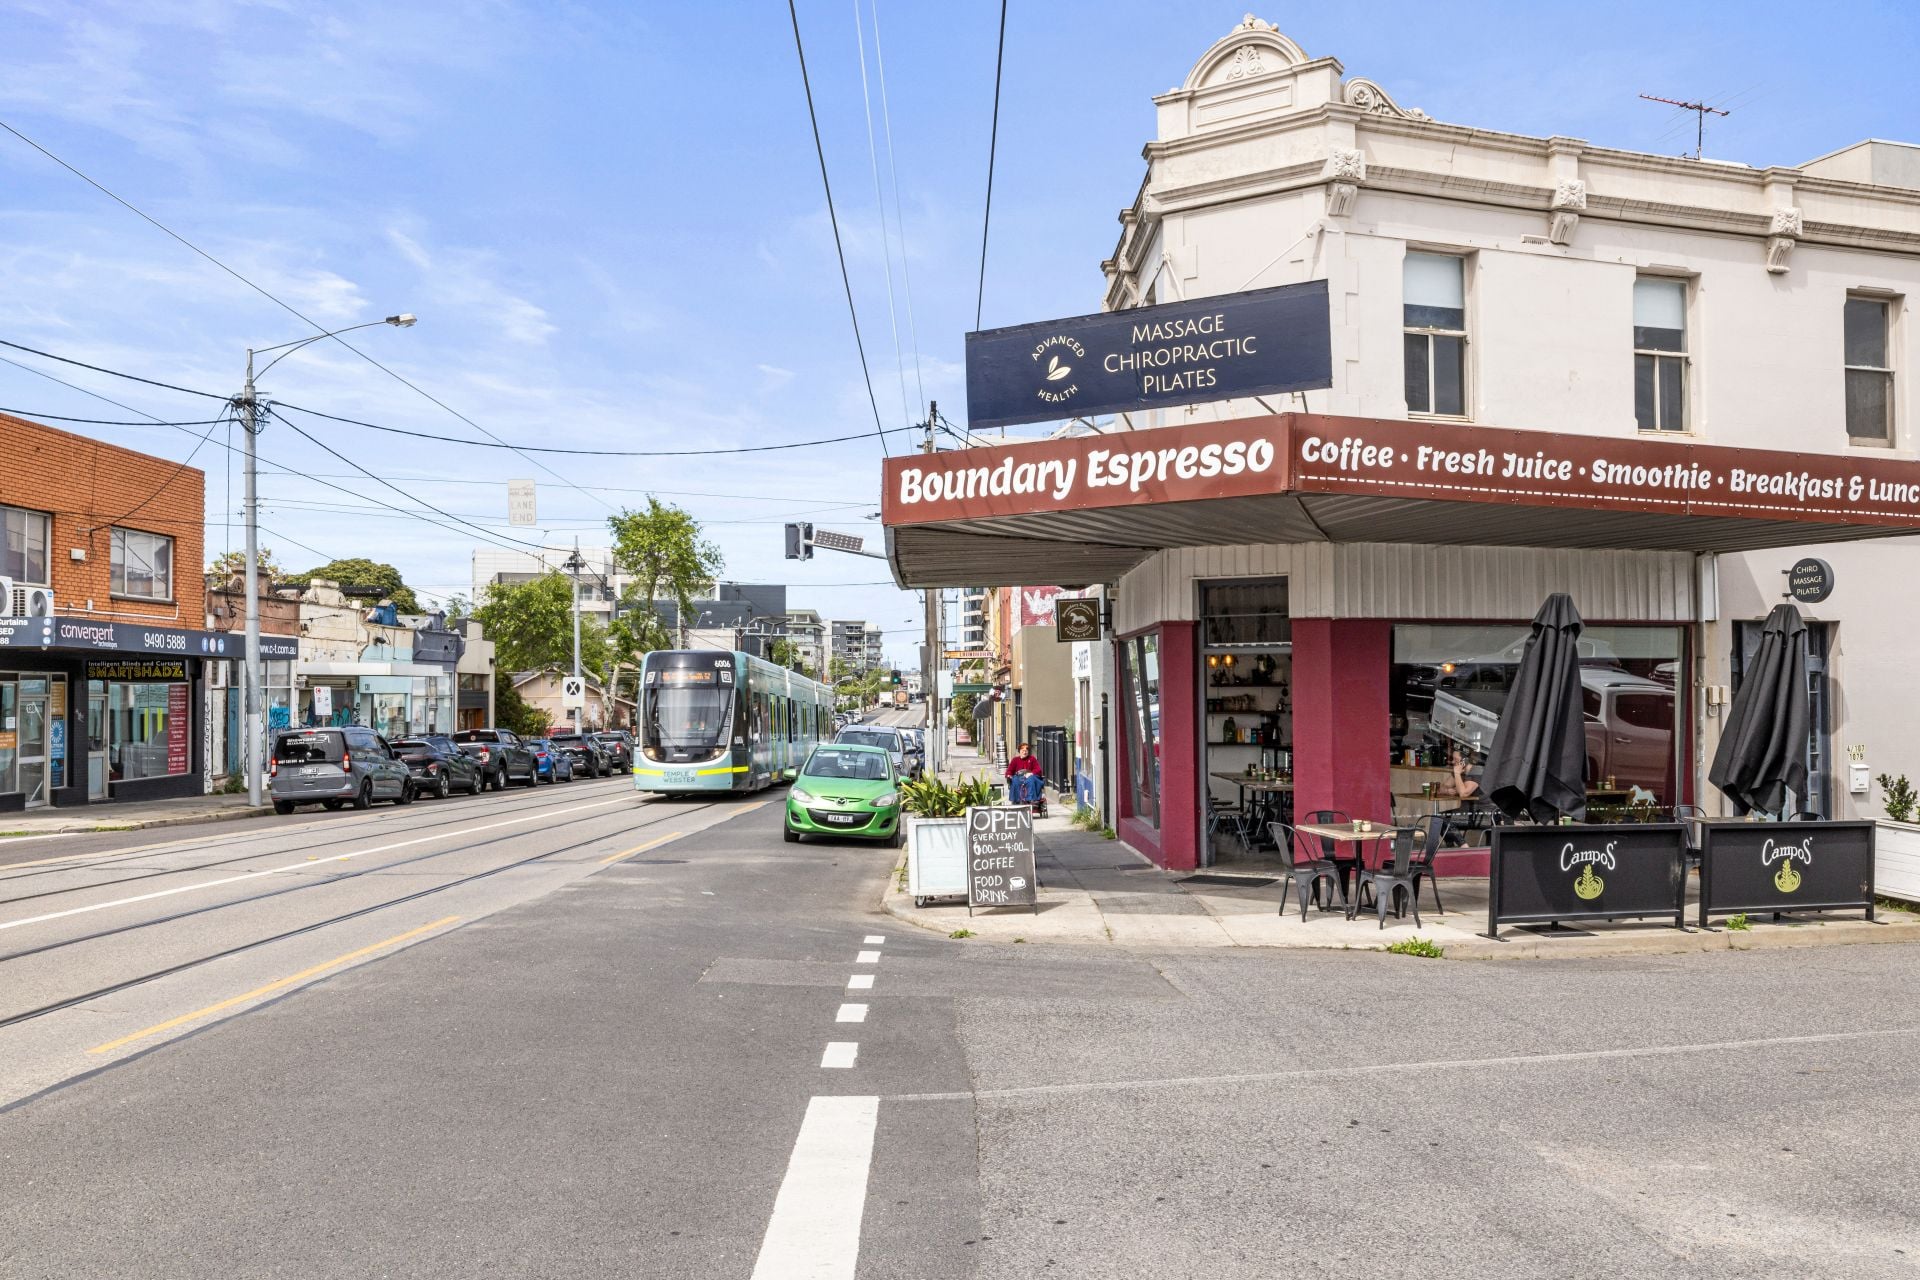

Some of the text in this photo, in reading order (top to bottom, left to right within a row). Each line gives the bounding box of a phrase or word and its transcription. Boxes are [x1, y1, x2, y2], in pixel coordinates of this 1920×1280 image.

[1132, 315, 1225, 344] MASSAGE
[1032, 335, 1085, 361] ADVANCED
[1104, 336, 1258, 373] CHIROPRACTIC
[1144, 368, 1217, 394] PILATES
[1037, 383, 1079, 402] HEALTH
[900, 438, 1274, 504] Boundary Espresso
[1302, 437, 1394, 471] Coffee
[1417, 446, 1495, 475] Fresh
[1502, 452, 1573, 480] Juice
[1591, 459, 1712, 490] Smoothie
[1730, 468, 1844, 501] Breakfast
[1849, 476, 1865, 501] &
[512, 513, 533, 522] END
[1796, 565, 1818, 574] CHIRO
[1793, 576, 1822, 586] MASSAGE
[1796, 587, 1820, 596] PILATES
[0, 618, 28, 626] urtains
[60, 624, 114, 645] convergent
[144, 632, 186, 650] 9490 5888
[121, 660, 140, 668] Blinds
[714, 659, 731, 668] 6006
[973, 809, 1031, 833] OPEN
[972, 831, 1017, 842] EVERYDAY
[973, 856, 1015, 871] COFFEE
[974, 875, 1003, 889] FOOD
[975, 889, 1009, 903] DRINK
